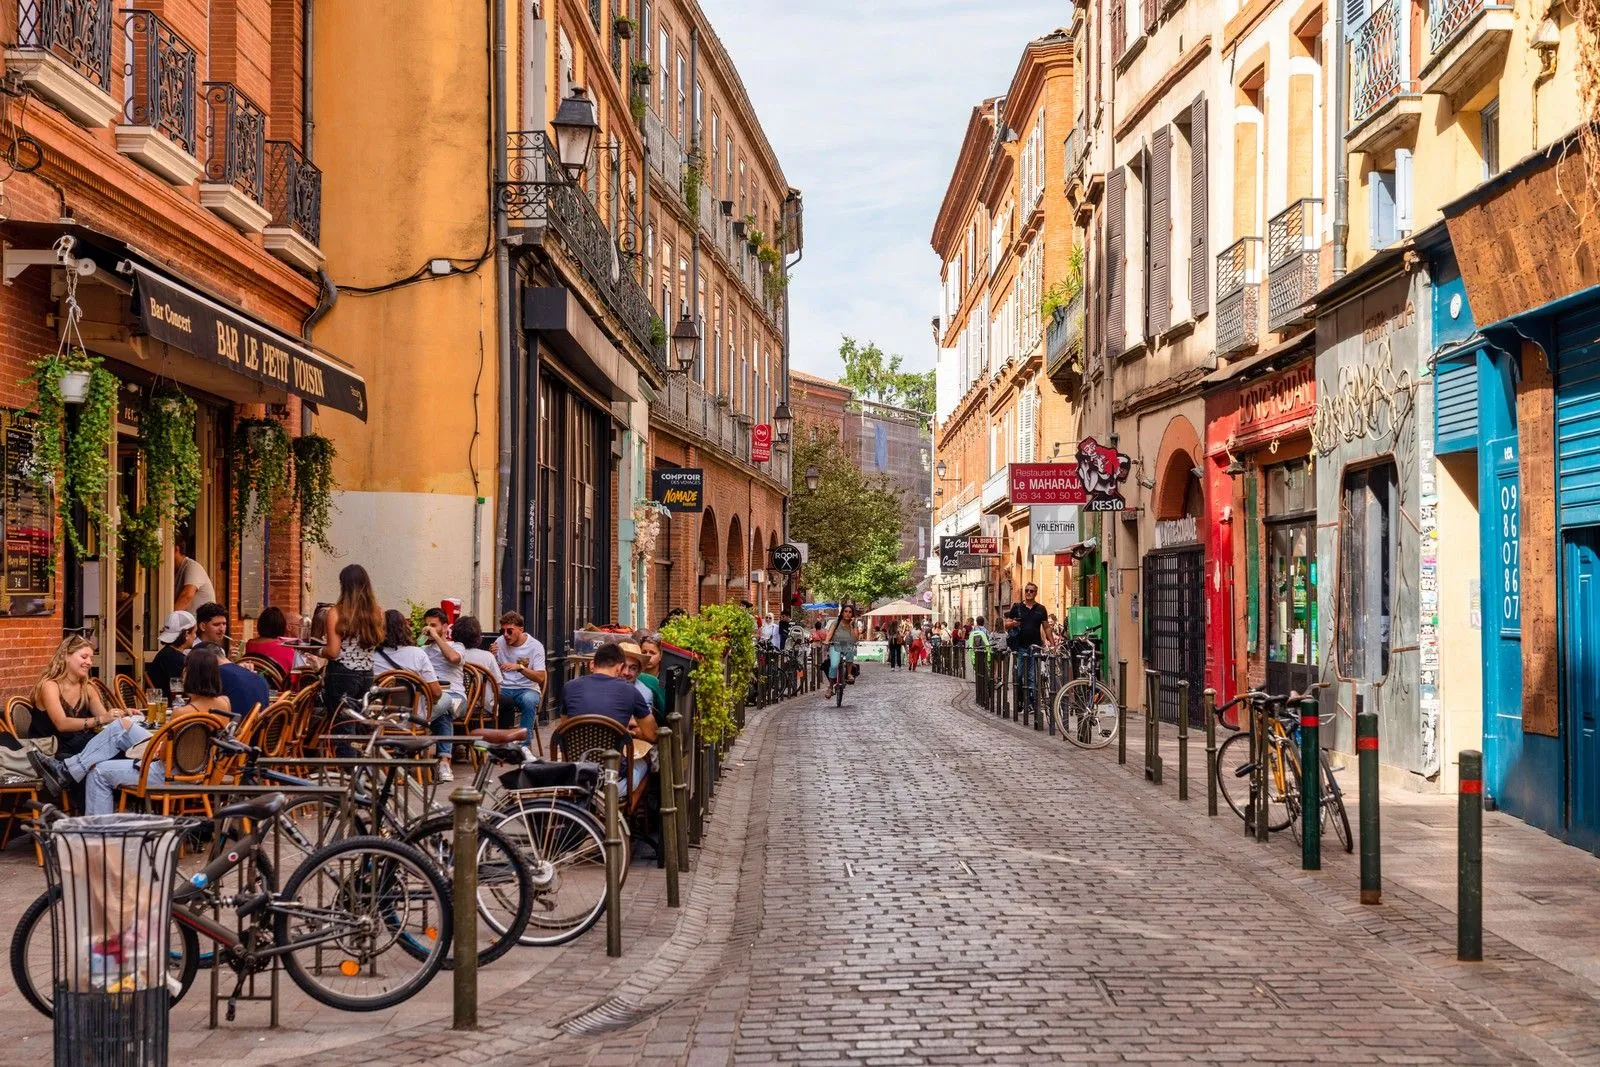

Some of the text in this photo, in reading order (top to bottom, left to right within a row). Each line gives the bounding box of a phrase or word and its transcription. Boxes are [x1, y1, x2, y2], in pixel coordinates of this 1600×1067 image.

[150, 297, 192, 333] Bar Concert
[216, 320, 240, 363] BAR
[244, 334, 259, 371] LE
[262, 341, 290, 383] PETIT
[293, 356, 325, 398] VOISIN
[660, 473, 701, 481] COMPTOIR
[1015, 469, 1057, 477] Restaurant
[1013, 479, 1026, 490] Le
[663, 488, 698, 504] NOMADE
[1016, 492, 1082, 500] 05 34 30 50 12
[1501, 484, 1517, 511] 09
[1092, 499, 1125, 511] RESTO
[1036, 523, 1076, 532] VALENTINA
[1503, 512, 1518, 538] 86
[944, 538, 955, 549] La
[775, 551, 799, 560] ROOM
[1502, 540, 1519, 565] 07
[1504, 567, 1518, 593] 86
[1504, 595, 1519, 620] 07
